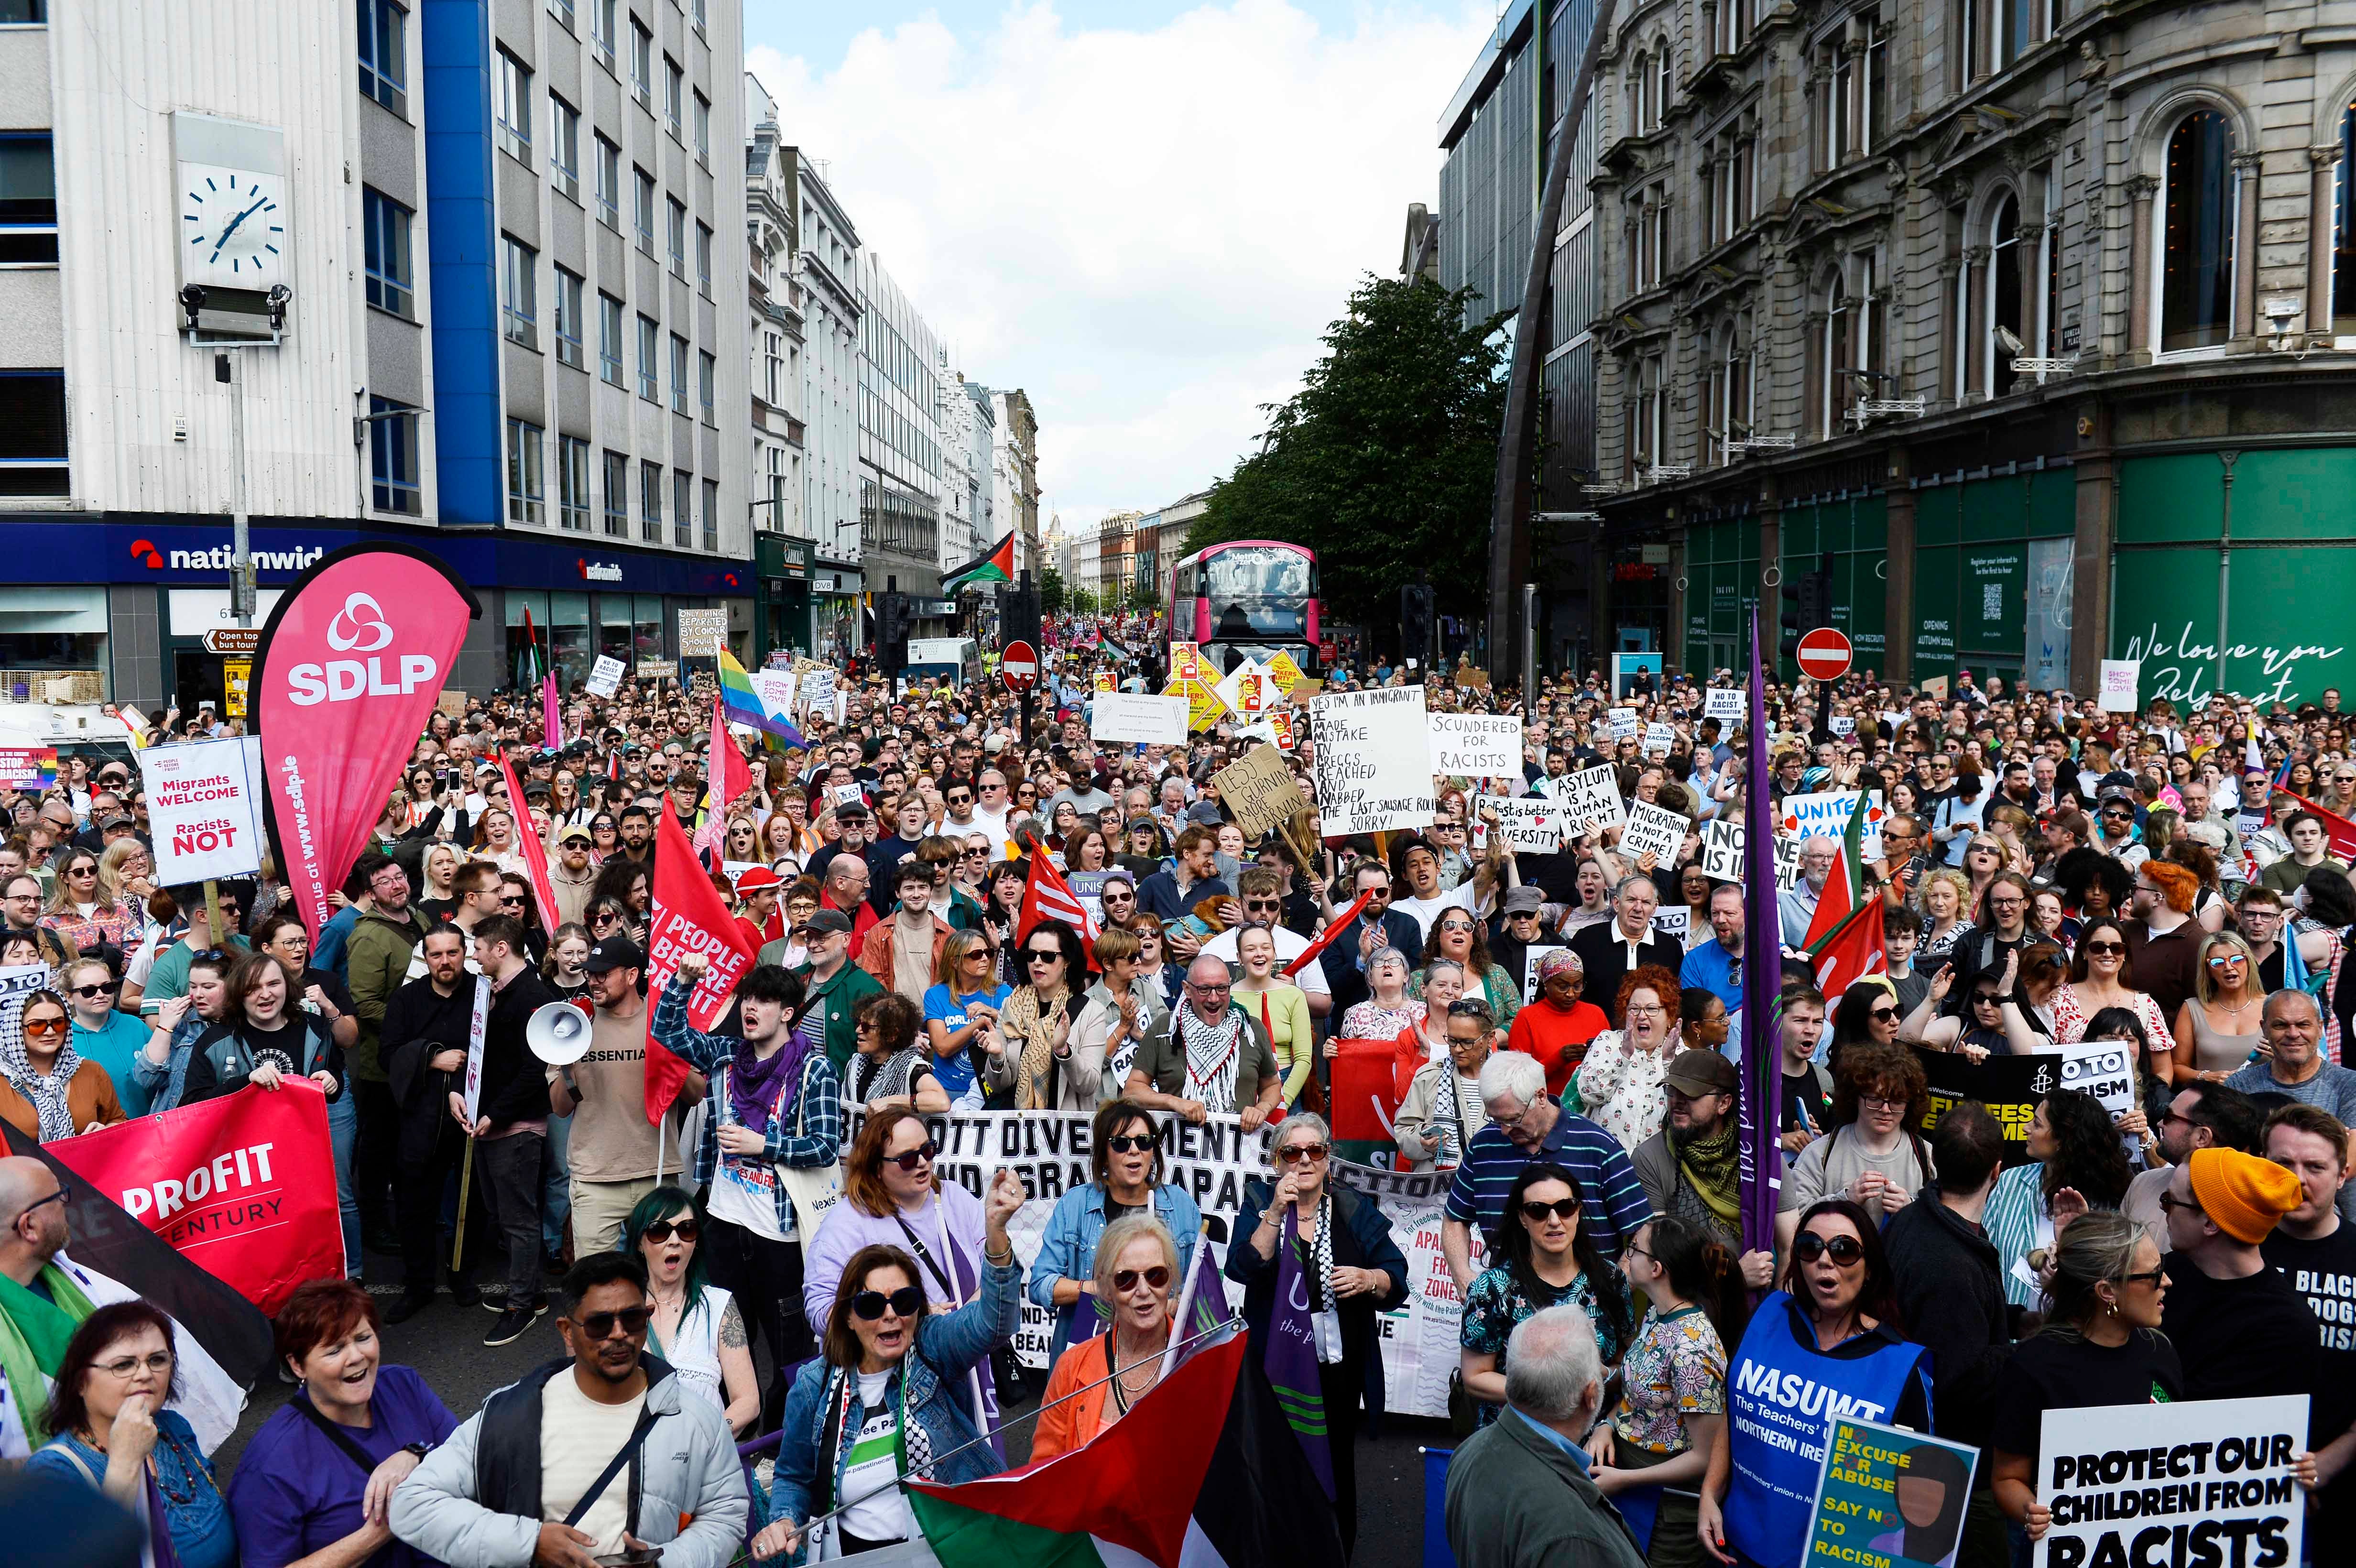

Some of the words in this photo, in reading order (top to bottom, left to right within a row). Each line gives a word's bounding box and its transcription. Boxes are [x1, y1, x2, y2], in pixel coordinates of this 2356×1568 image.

[680, 617, 727, 627] SEPARATED
[1923, 621, 1948, 631] OPENING
[219, 632, 241, 641] Open
[244, 632, 258, 641] top
[681, 627, 693, 636] BY
[1918, 636, 1941, 645] AUTUMN
[1941, 637, 1953, 647] 2024
[2126, 622, 2172, 665] We
[2179, 621, 2258, 661] love
[2262, 642, 2344, 675] you
[599, 664, 618, 674] RACIST
[2108, 670, 2133, 678] SHOW
[288, 654, 437, 706] SDLP
[765, 680, 788, 688] SHOW
[2107, 684, 2132, 692] LOVE
[764, 688, 787, 696] SOME
[1312, 696, 1330, 709] YES
[1334, 695, 1348, 708] I'M
[1354, 693, 1364, 707] AN
[1370, 689, 1420, 705] IMMIGRANT
[1611, 711, 1622, 719] NO
[1612, 719, 1635, 727] RACISM
[1314, 719, 1348, 733] MADE
[1432, 716, 1518, 733] SCUNDERED
[1314, 727, 1368, 743] MISTAKE
[1463, 736, 1489, 747] FOR
[0, 757, 24, 768] STOP
[1440, 751, 1505, 769] RACISTS
[0, 769, 37, 779] RACISM
[1219, 758, 1257, 793] LESS
[1317, 764, 1376, 782] REACHED
[1558, 767, 1611, 795] ASYLUM
[163, 775, 229, 792] Migrants
[1241, 765, 1291, 803] GURNIN
[1319, 780, 1345, 794] AND
[156, 786, 239, 806] WELCOME
[845, 788, 858, 798] TO
[1320, 788, 1364, 806] NABBED
[1568, 794, 1579, 806] IS
[1586, 790, 1596, 800] A
[1237, 796, 1271, 824] MORE
[1248, 795, 1302, 836] LEARNIN
[1320, 805, 1342, 820] THE
[1350, 801, 1375, 816] LAST
[1377, 797, 1413, 812] SAUSAGE
[1525, 804, 1556, 815] better
[1562, 796, 1612, 818] HUMAN
[1794, 797, 1873, 820] UNITED
[176, 819, 230, 835] Racists
[1349, 815, 1393, 832] SORRY!
[1633, 804, 1688, 834] MIGRATION
[173, 828, 237, 856] NOT
[1631, 824, 1641, 832] IS
[1643, 827, 1660, 838] NOT
[1664, 833, 1672, 843] A
[1627, 835, 1672, 859] CRIME!
[1705, 850, 1724, 872] IS
[305, 862, 319, 879] at
[312, 882, 324, 899] us
[1663, 912, 1687, 928] TO
[665, 914, 745, 973] PEOPLE
[13, 973, 44, 989] TO
[2084, 1052, 2123, 1075] TO
[121, 1142, 273, 1220] PROFIT
[749, 1172, 763, 1185] AND
[1404, 1224, 1414, 1236] For
[1414, 1210, 1441, 1228] freedom,
[1422, 1299, 1434, 1310] with
[1436, 1303, 1444, 1315] the
[1280, 1318, 1302, 1338] the
[1735, 1358, 1886, 1422] NASUWT
[1735, 1394, 1754, 1412] The
[1757, 1403, 1820, 1435] Teachers'
[1735, 1415, 1797, 1453] NORTHERN
[1835, 1439, 1912, 1469] EXCUSE
[2053, 1441, 2213, 1490] PROTECT
[2215, 1434, 2294, 1473] OUR
[1829, 1466, 1896, 1494] ABUSE
[1774, 1485, 1794, 1498] union
[1795, 1492, 1803, 1501] in
[2050, 1483, 2200, 1527] CHILDREN
[2204, 1477, 2293, 1513] FROM
[1823, 1496, 1863, 1517] SAY
[1820, 1518, 1846, 1536] TO
[2045, 1515, 2290, 1568] RACISTS
[1814, 1541, 1891, 1568] RACISM
